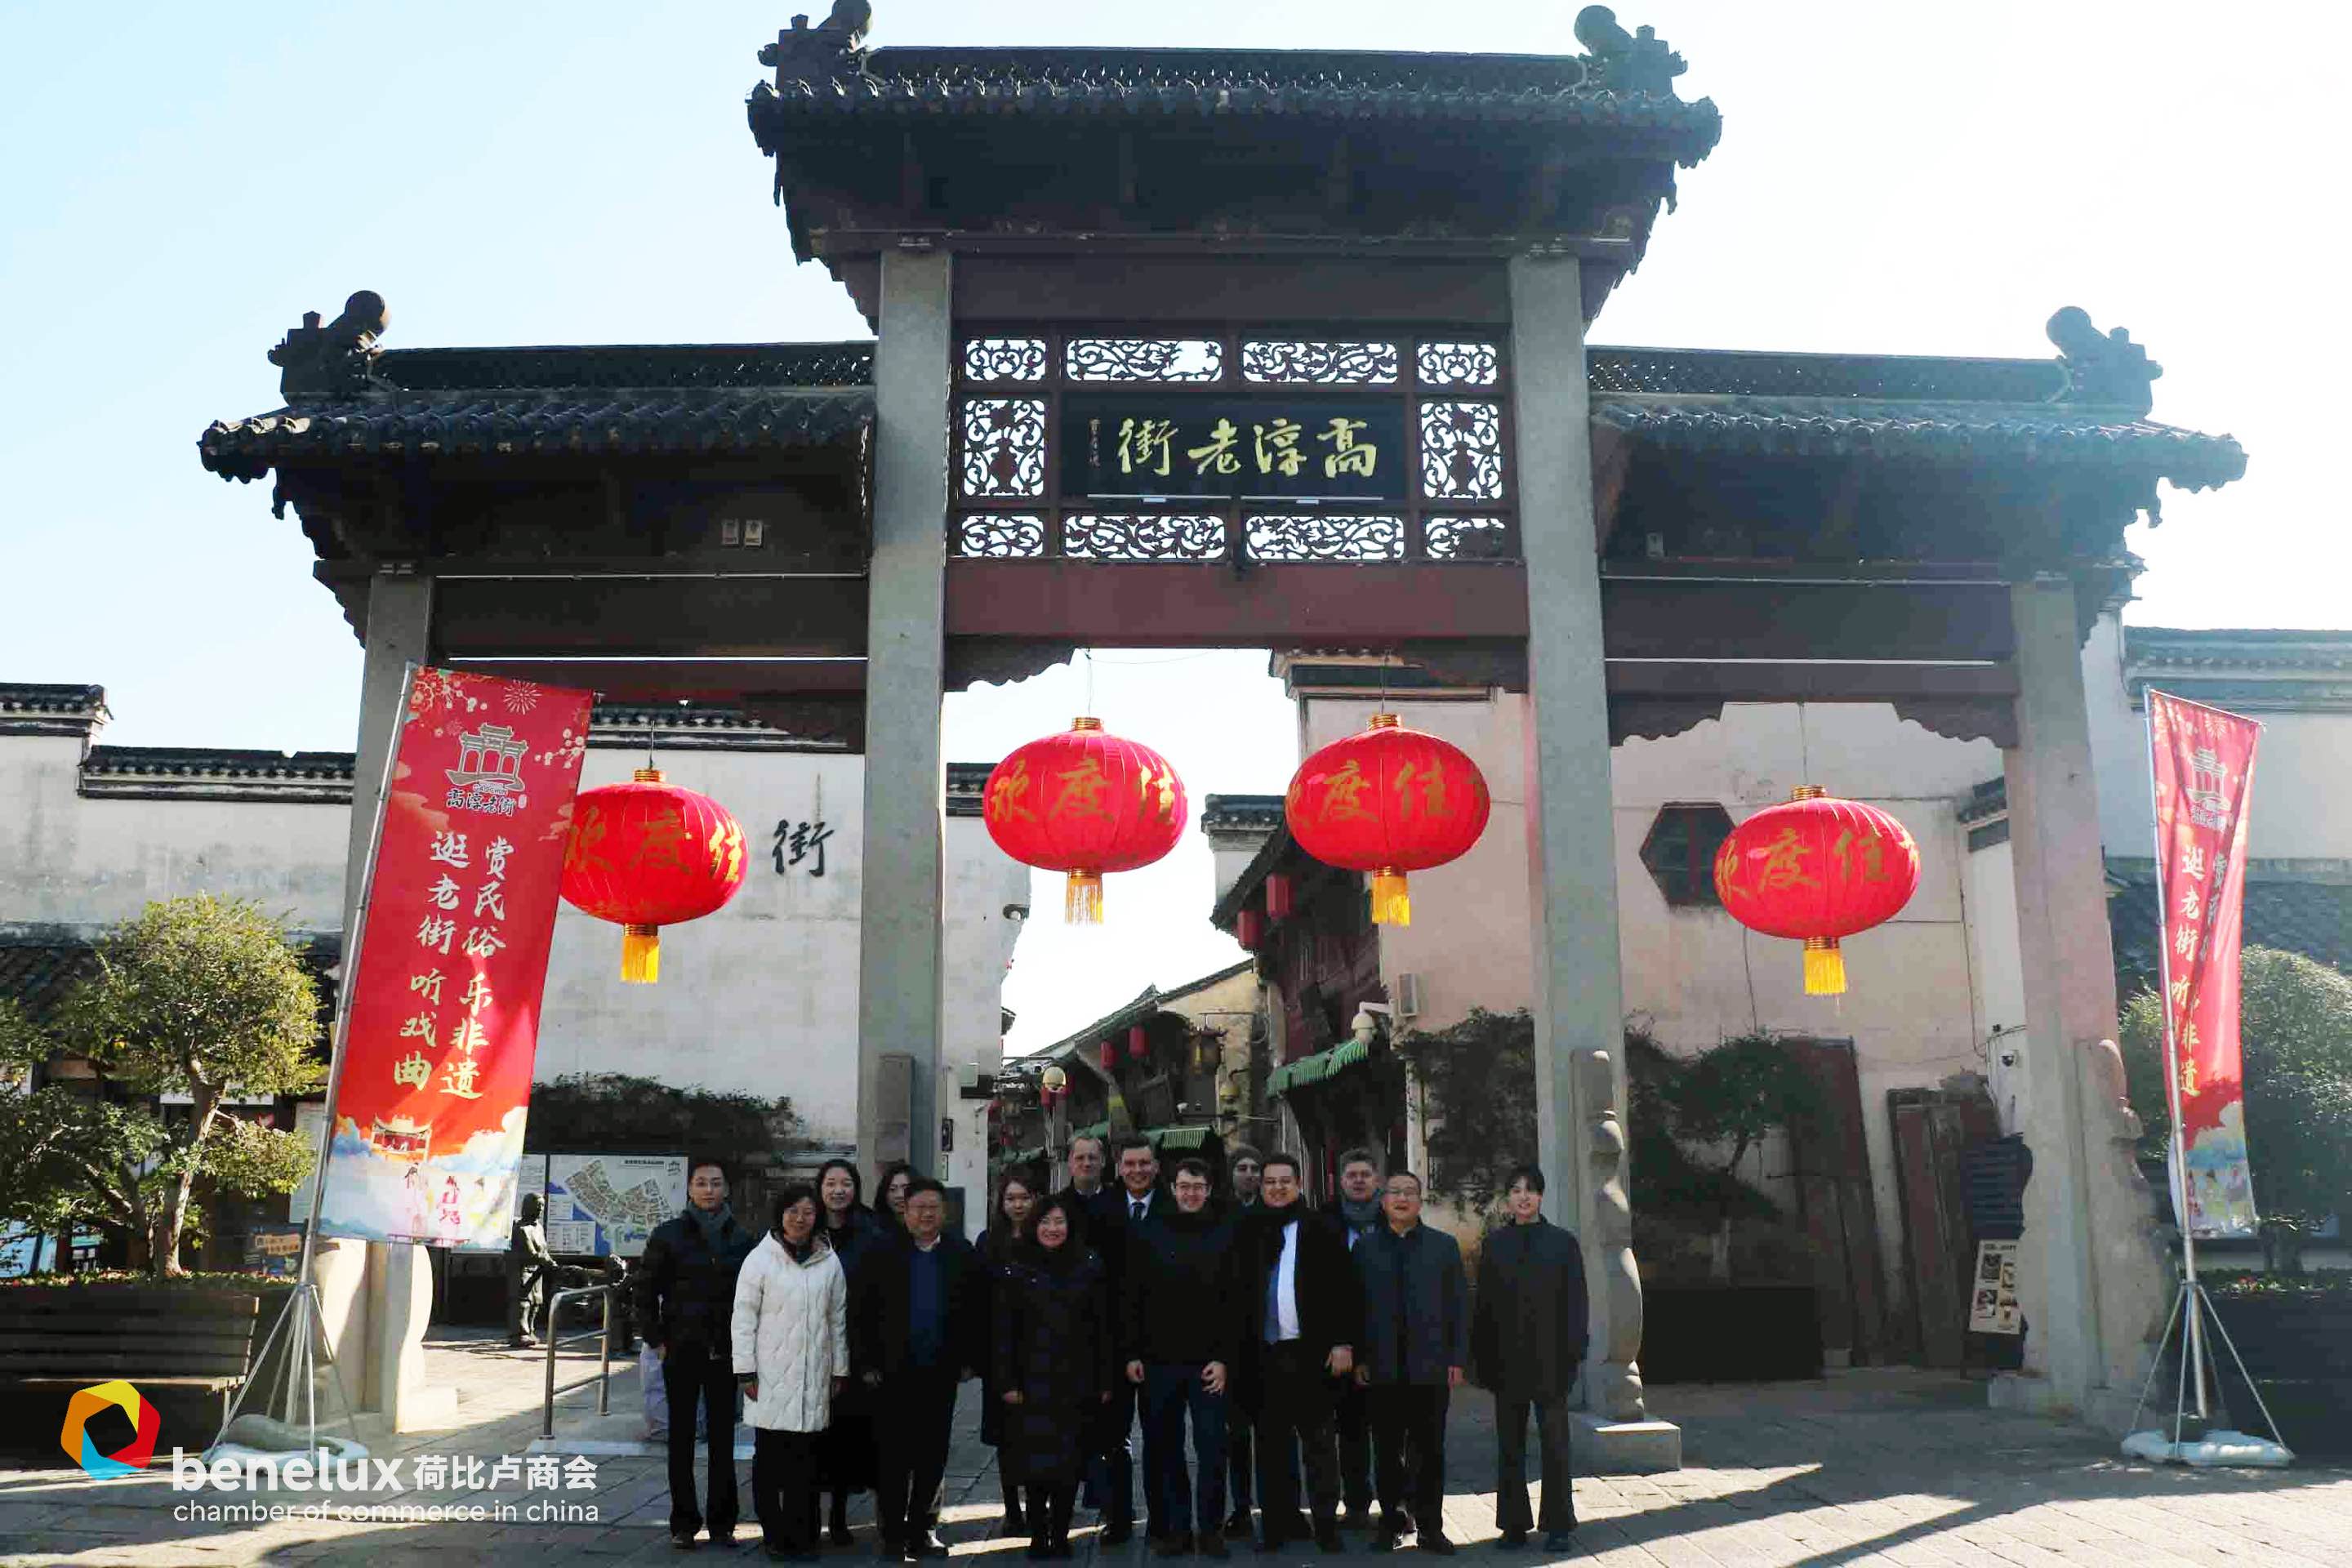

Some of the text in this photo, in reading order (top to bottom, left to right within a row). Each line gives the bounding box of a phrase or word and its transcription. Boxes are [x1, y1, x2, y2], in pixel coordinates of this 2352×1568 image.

[394, 831, 470, 1091] 逛老街 听戏曲
[438, 835, 514, 1100] 赏民俗 乐非遗
[773, 818, 835, 877] 街
